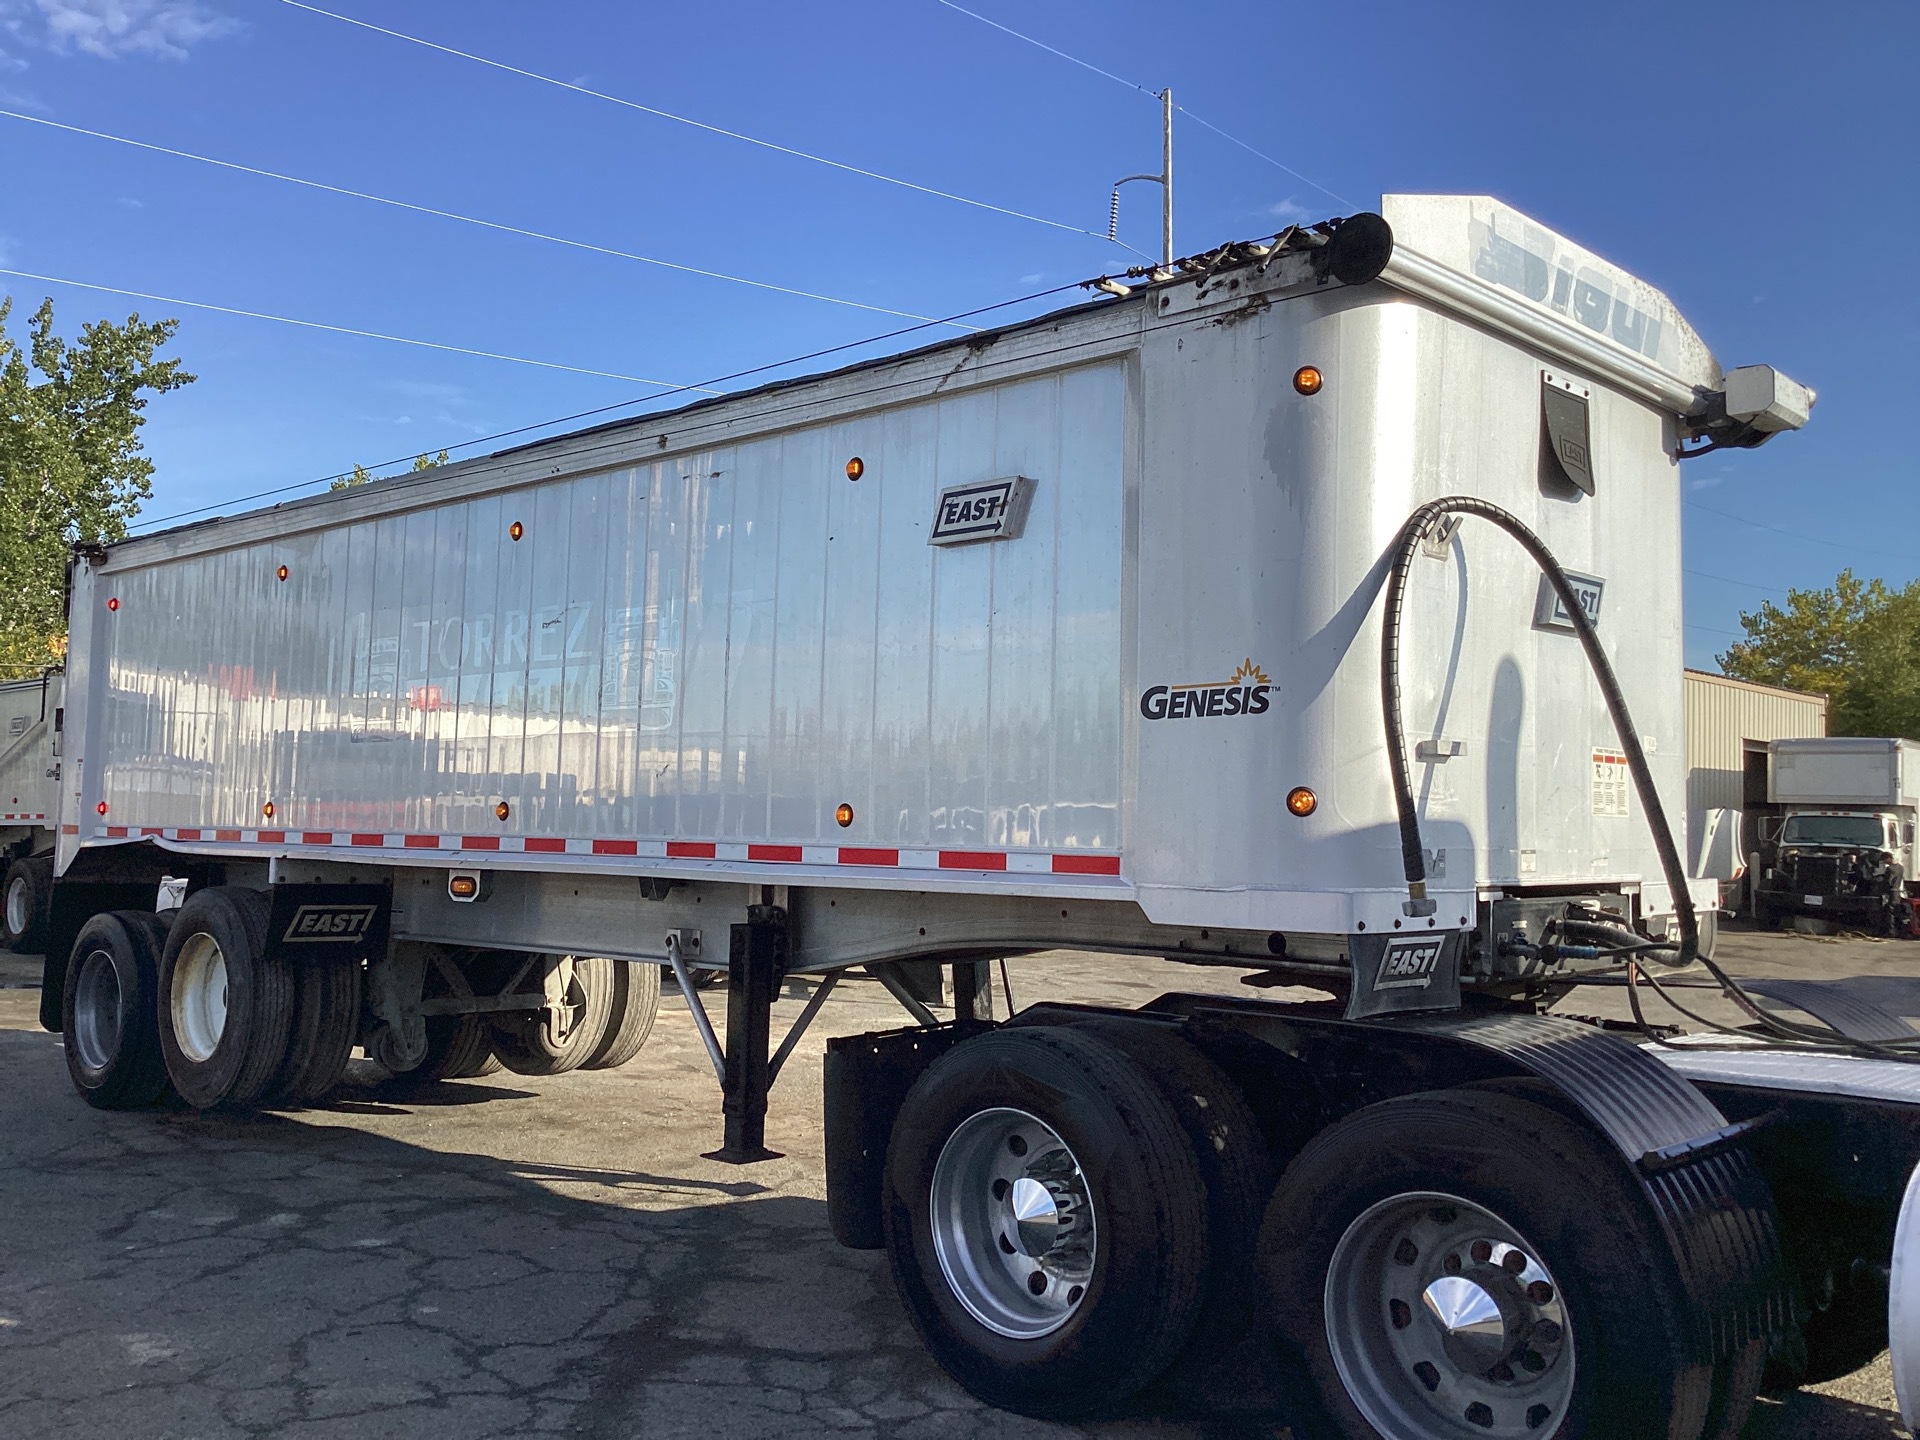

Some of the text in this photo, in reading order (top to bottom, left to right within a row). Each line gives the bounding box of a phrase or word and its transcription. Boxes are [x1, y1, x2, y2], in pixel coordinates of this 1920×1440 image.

[944, 496, 1000, 525] EAST
[413, 601, 593, 673] TORREZ
[1140, 685, 1270, 720] GENESIS
[298, 914, 364, 932] EAST
[1384, 949, 1436, 976] EAST
